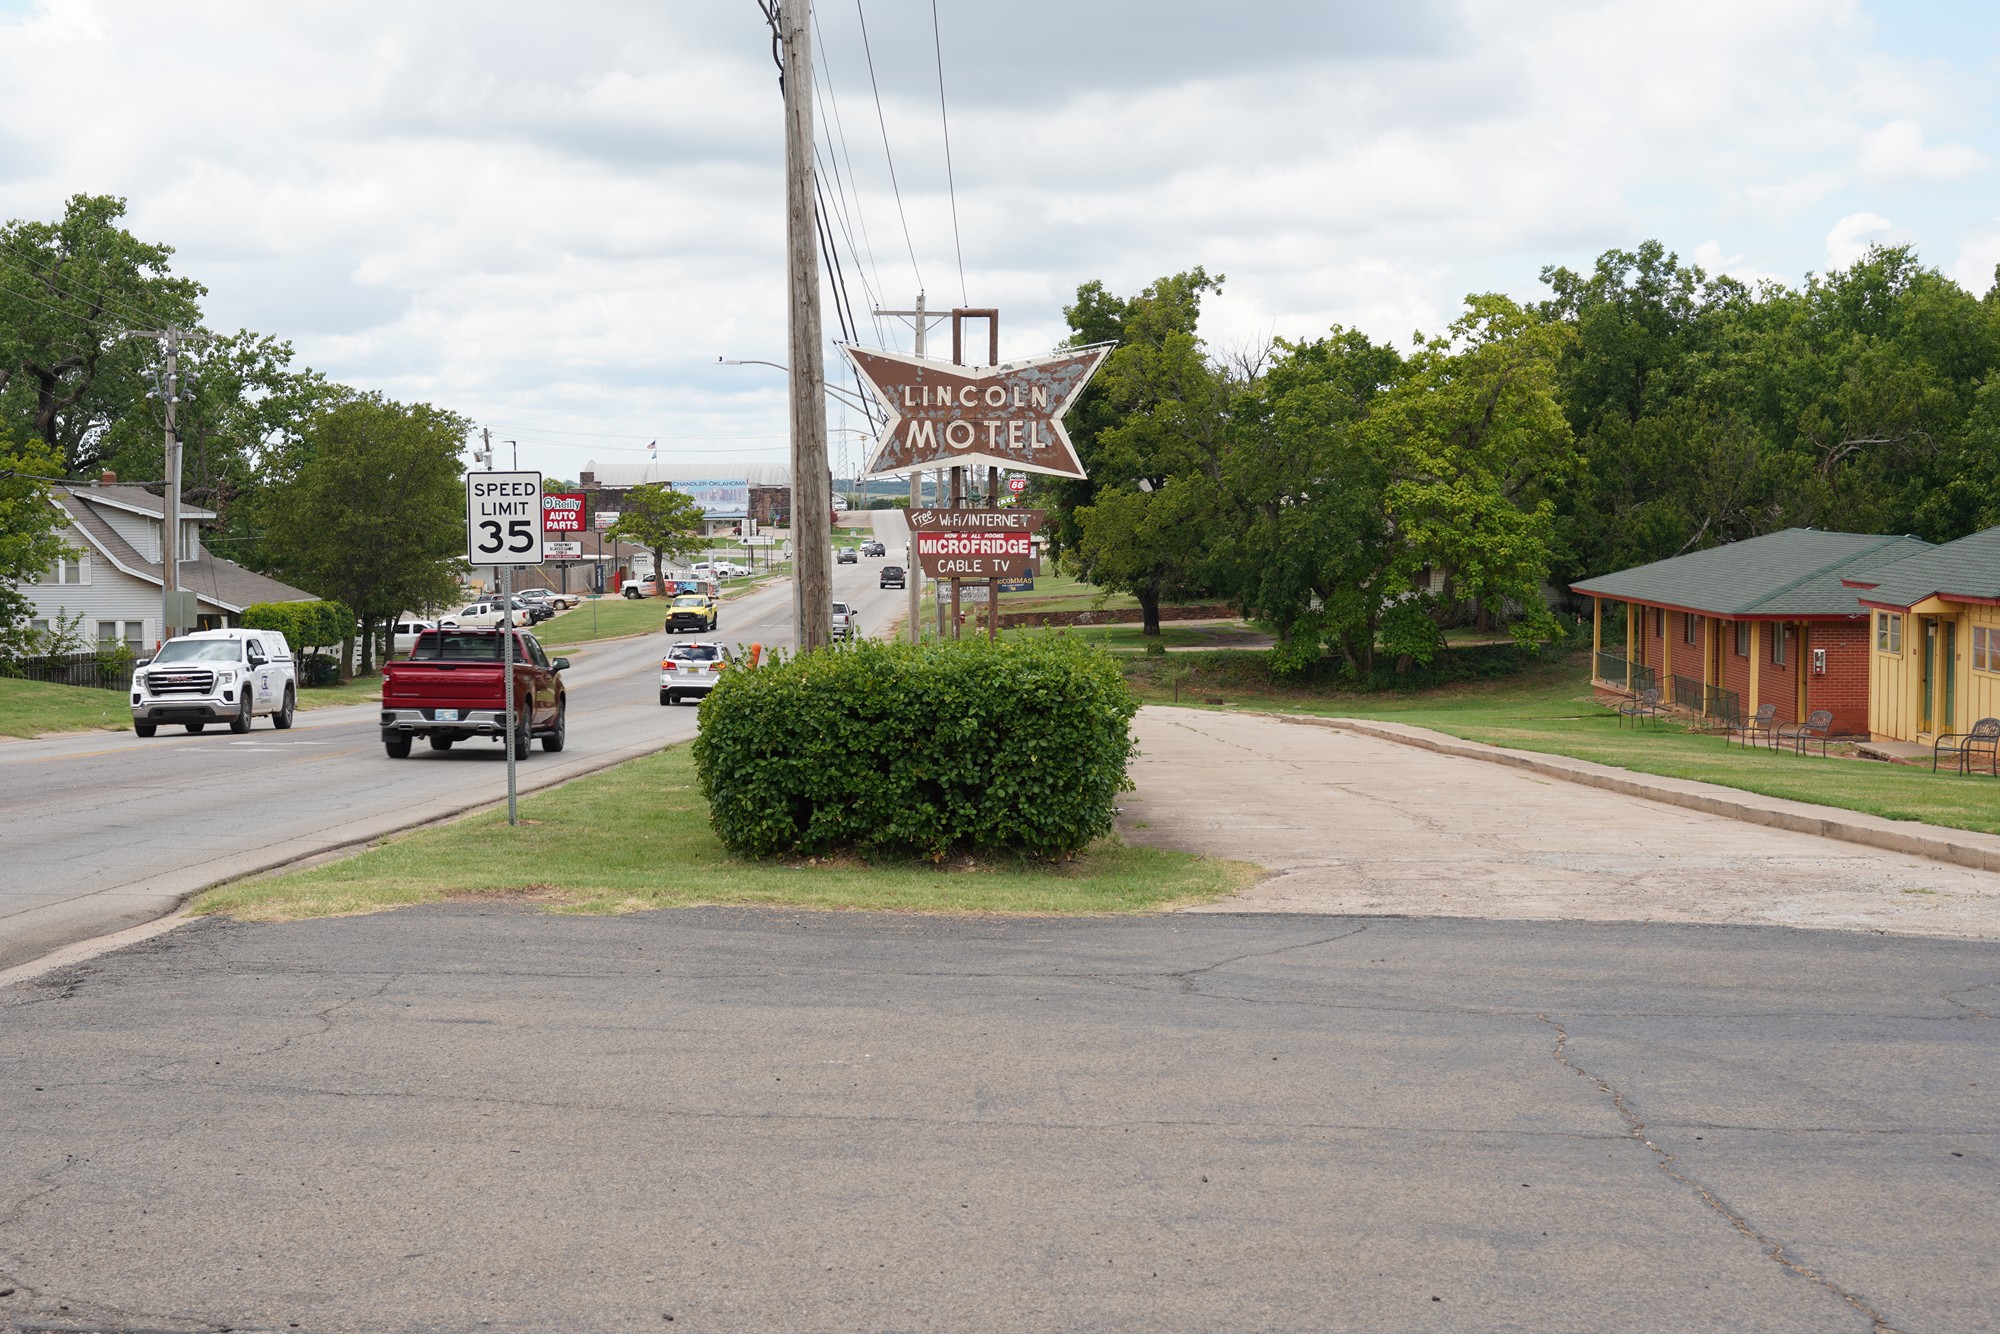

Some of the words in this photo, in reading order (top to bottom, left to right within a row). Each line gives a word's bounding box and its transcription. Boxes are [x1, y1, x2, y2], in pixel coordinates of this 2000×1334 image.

[905, 385, 1047, 407] LINCOLN
[905, 420, 1046, 449] MOTEL
[474, 483, 536, 497] SPEED
[1011, 481, 1024, 489] 66
[481, 502, 529, 516] LIMIT
[543, 496, 581, 511] O'Reilly
[549, 511, 576, 520] AUTO
[911, 510, 936, 529] Free
[546, 521, 579, 530] PARTS
[478, 520, 534, 553] 35
[919, 539, 1029, 554] MICROFRIDGE
[937, 559, 982, 573] CABLE
[992, 560, 1010, 572] TV
[997, 577, 1032, 585] cCOMMAS
